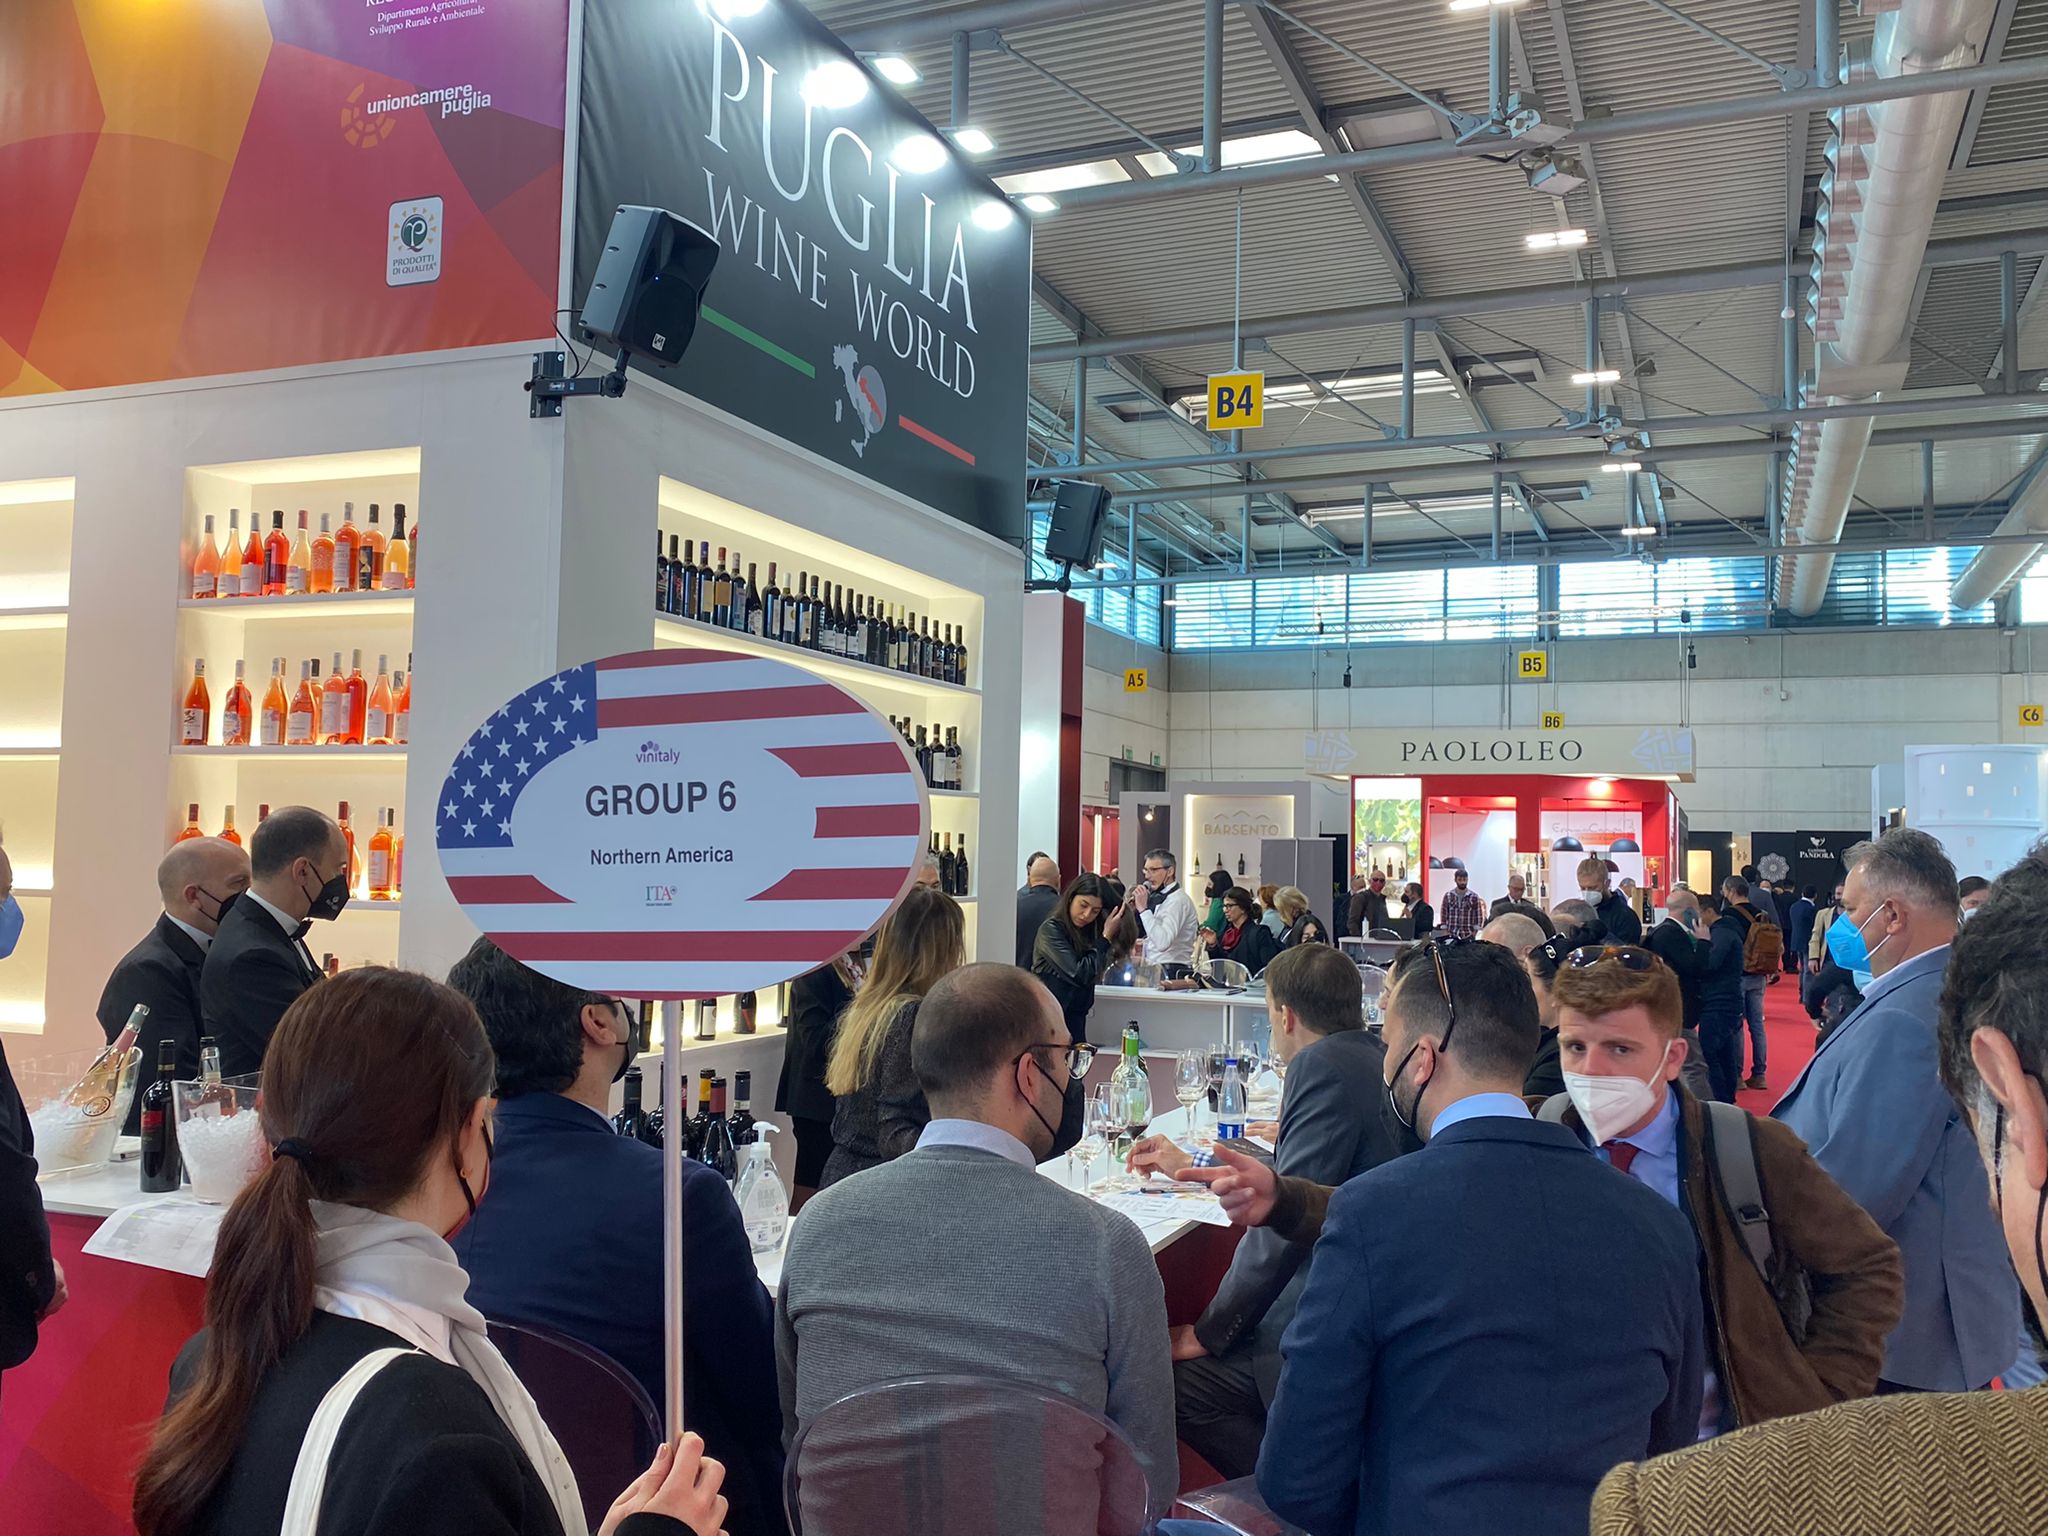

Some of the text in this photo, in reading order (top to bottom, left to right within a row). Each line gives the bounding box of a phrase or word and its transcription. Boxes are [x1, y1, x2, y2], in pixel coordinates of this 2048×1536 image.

[369, 5, 486, 36] Sviluppo Rurale e Ambientale
[377, 5, 428, 22] Dipartimento
[367, 84, 473, 114] unioncamere
[441, 91, 491, 119] puglia
[704, 15, 979, 334] PUGLIA
[393, 254, 434, 267] PRODOTTI
[393, 267, 401, 275] DI
[702, 167, 976, 399] WINE WORLD
[1217, 384, 1254, 418] B4
[1523, 657, 1542, 672] B5
[1127, 673, 1144, 687] A5
[1544, 715, 1560, 728] B6
[2023, 708, 2039, 722] C6
[636, 748, 680, 765] vinitaly
[1401, 740, 1582, 762] PAOLOLEO
[585, 780, 737, 817] GROUP 6
[1204, 823, 1280, 836] BARSENTO
[590, 846, 734, 866] Northern America
[1800, 851, 1835, 859] PANDORA
